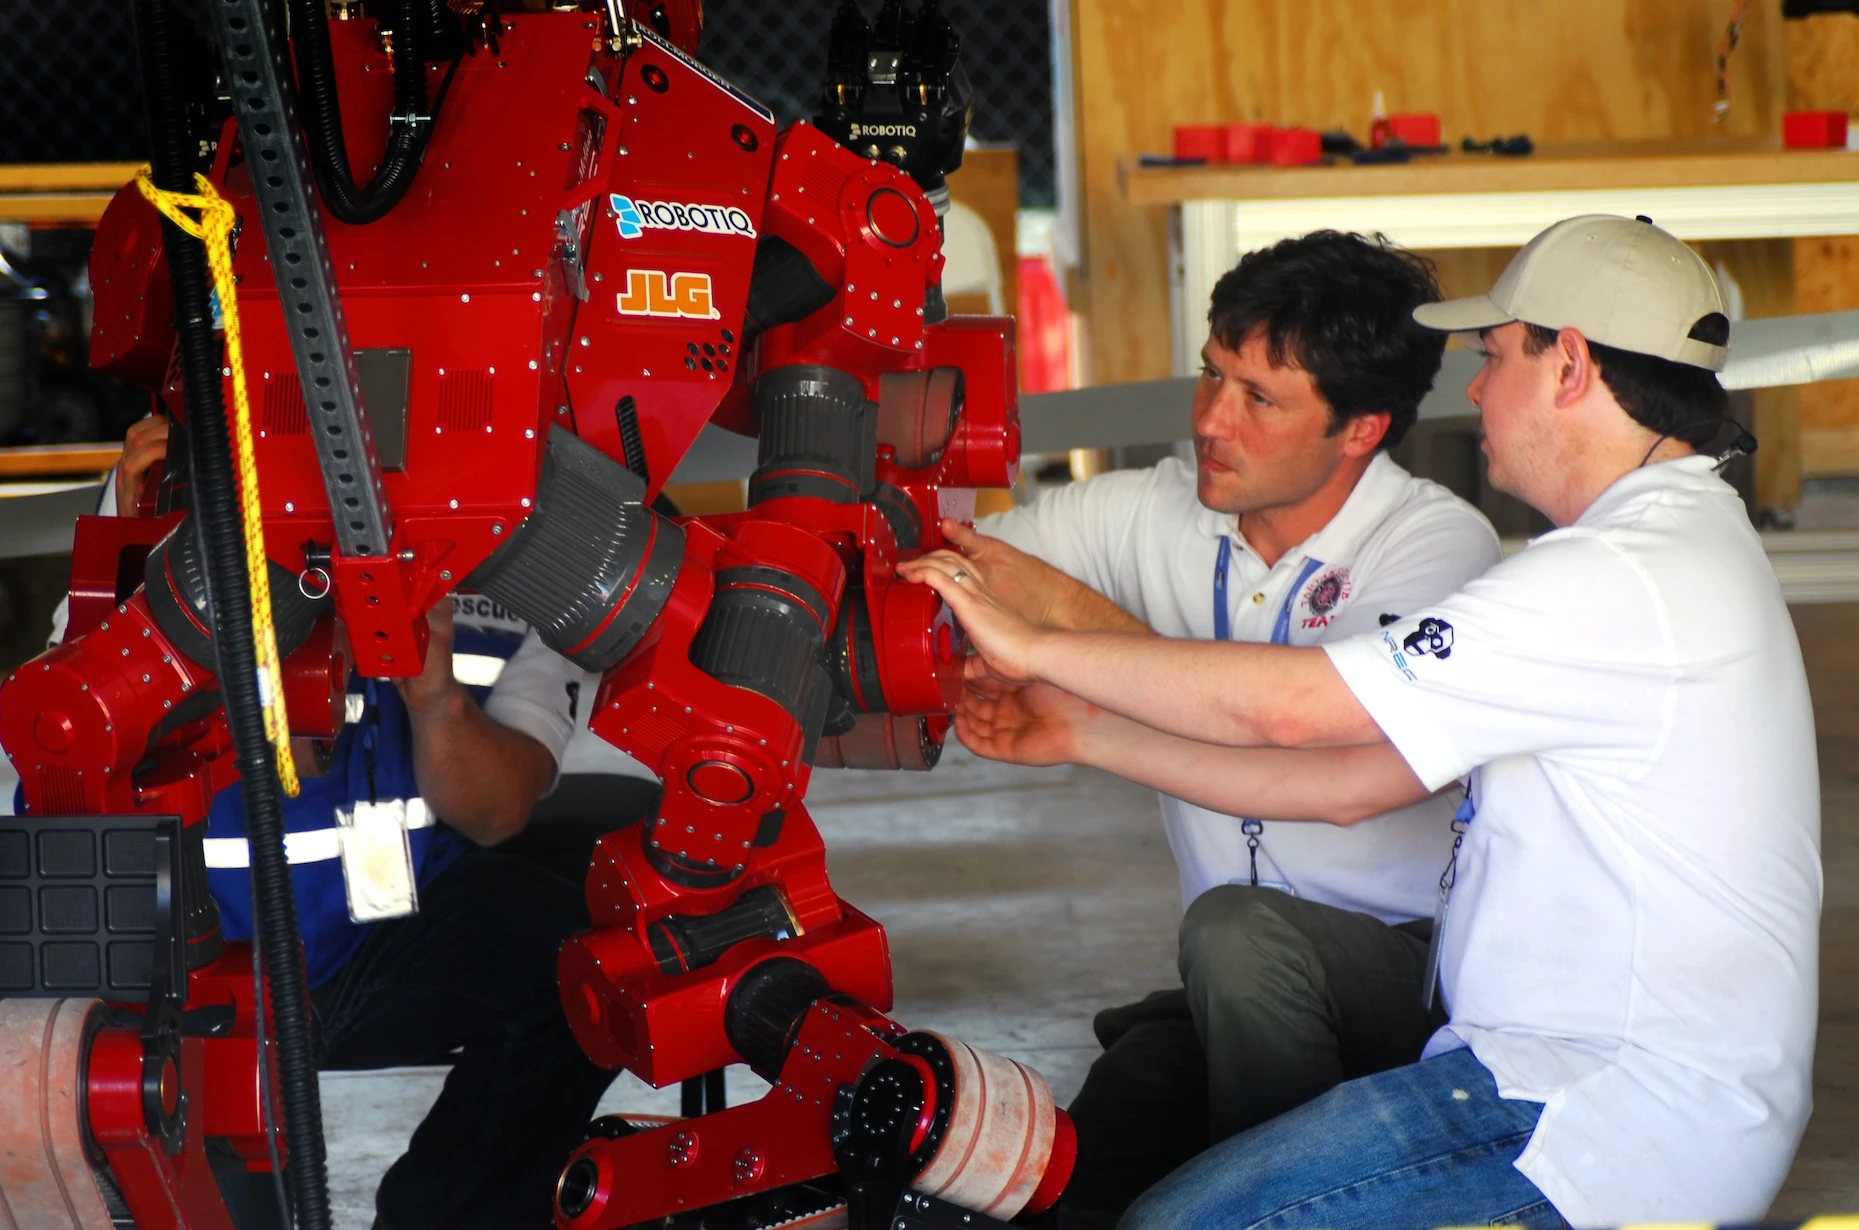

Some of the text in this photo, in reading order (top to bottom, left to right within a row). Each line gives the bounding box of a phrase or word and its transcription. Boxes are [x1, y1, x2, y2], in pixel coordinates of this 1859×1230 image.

[862, 125, 916, 137] ROBOTIQ
[638, 203, 753, 235] ROBOTIQ
[620, 273, 711, 315] JLG
